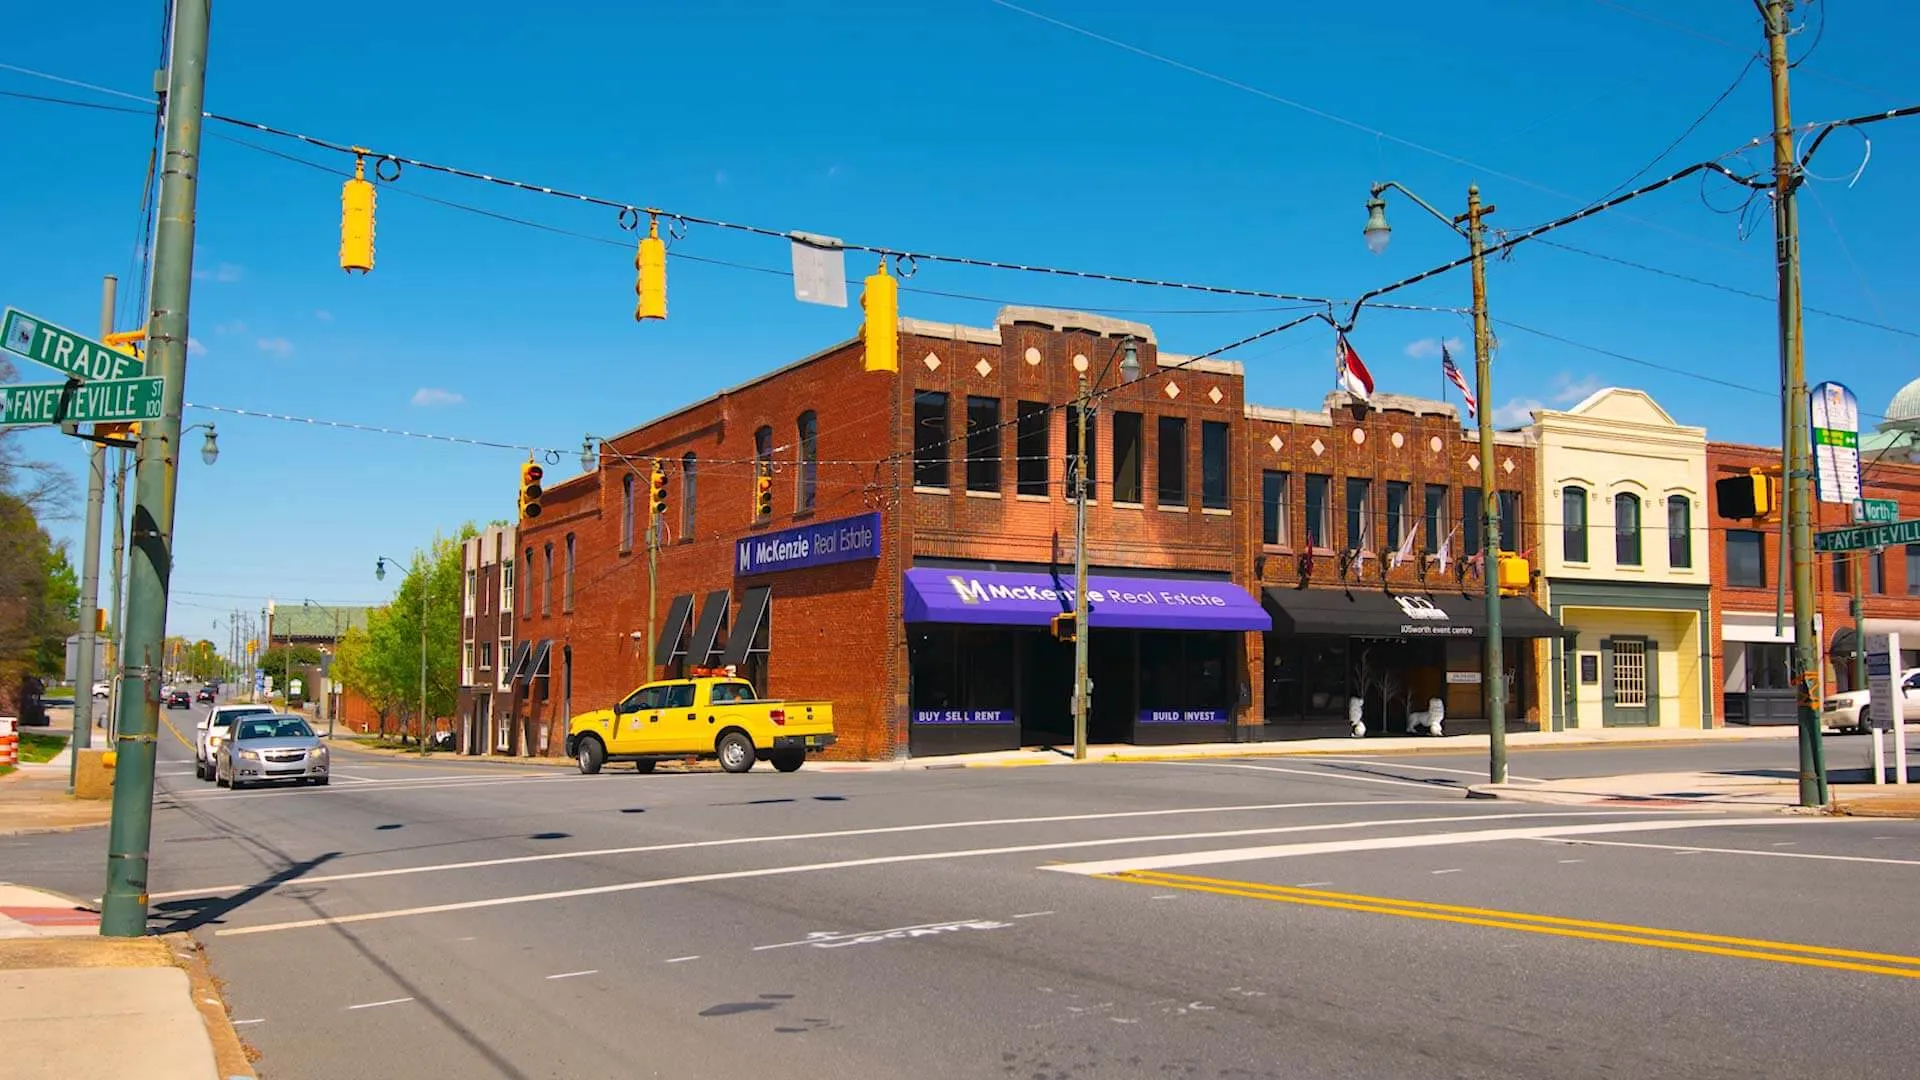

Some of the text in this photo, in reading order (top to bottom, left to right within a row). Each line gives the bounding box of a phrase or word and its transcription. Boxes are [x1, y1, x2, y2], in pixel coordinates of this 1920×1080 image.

[40, 327, 129, 380] TRADE
[151, 380, 162, 397] ST
[1865, 501, 1890, 520] North
[740, 525, 872, 571] M McKenzie Real Estate
[988, 583, 1105, 602] McKene
[1107, 589, 1158, 605] Real
[1160, 591, 1226, 607] Estate
[1432, 626, 1451, 634] event
[1452, 626, 1473, 635] centre
[918, 711, 1001, 721] BUY SELL RENT
[1153, 711, 1216, 721] BUILD INVEST
